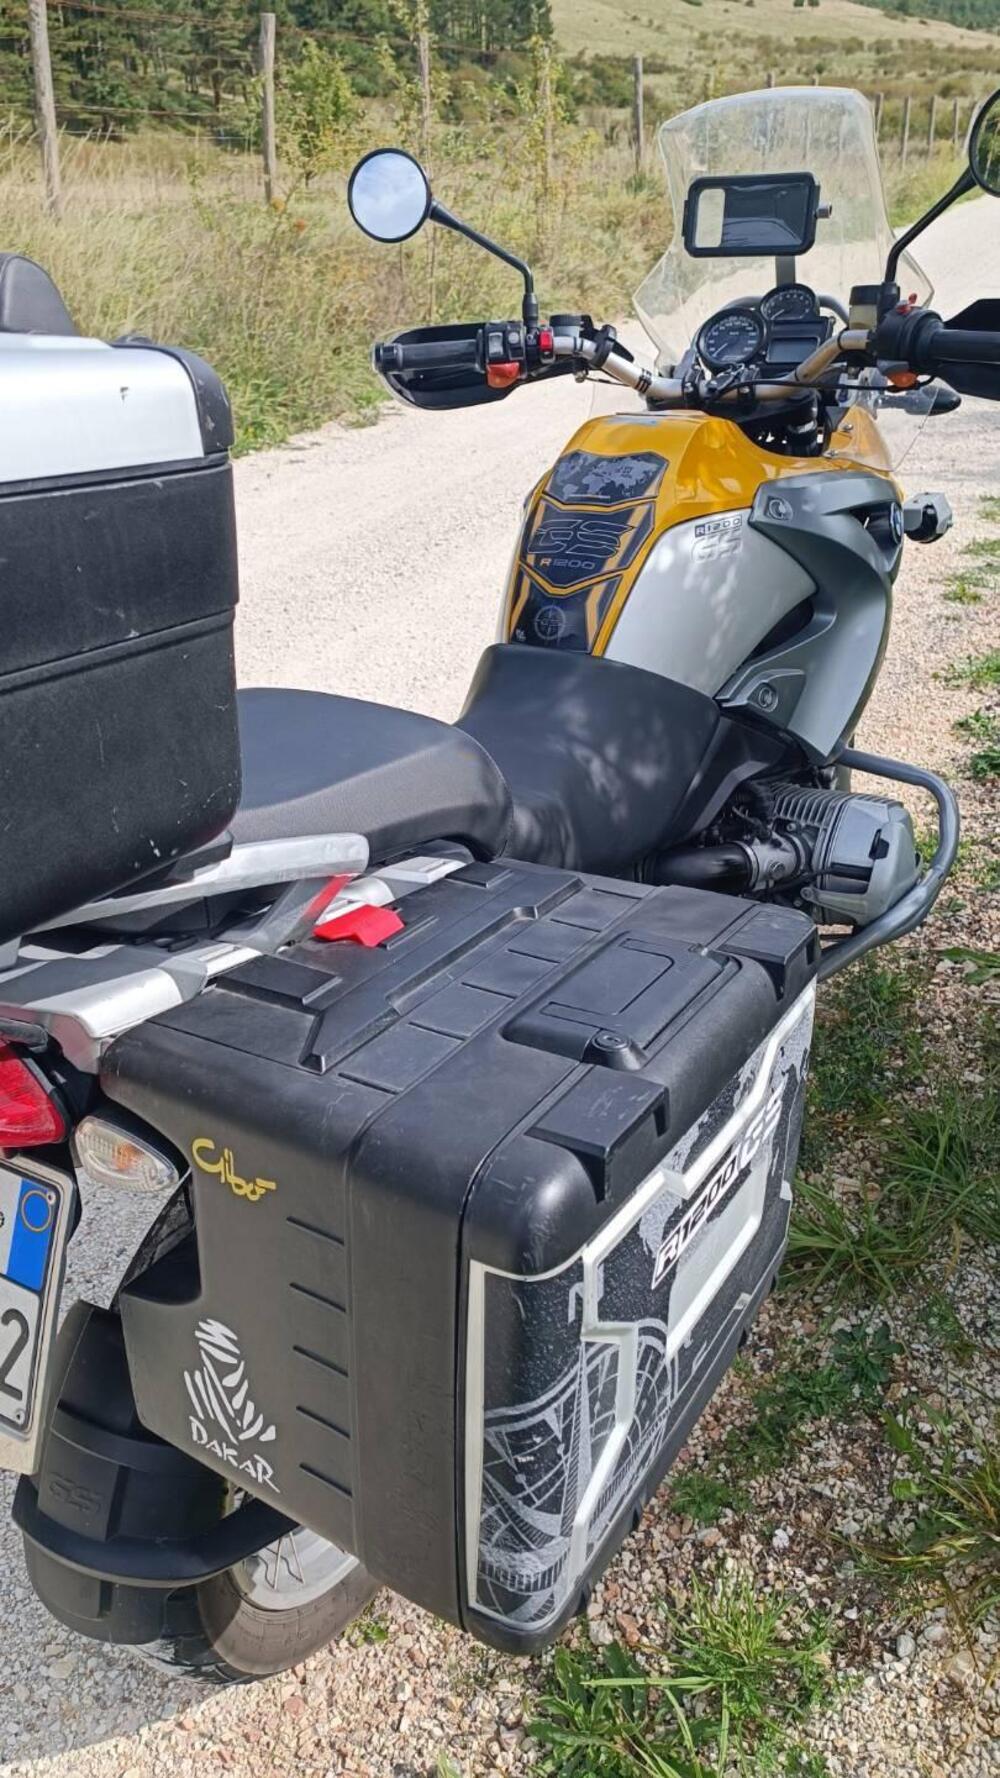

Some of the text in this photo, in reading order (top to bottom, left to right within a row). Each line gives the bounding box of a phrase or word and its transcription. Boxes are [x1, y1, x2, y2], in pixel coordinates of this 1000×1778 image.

[527, 519, 633, 558] GS
[695, 517, 741, 536] R1200
[540, 558, 596, 570] R1200
[655, 1155, 738, 1282] R1200
[189, 1415, 281, 1493] DAKAR
